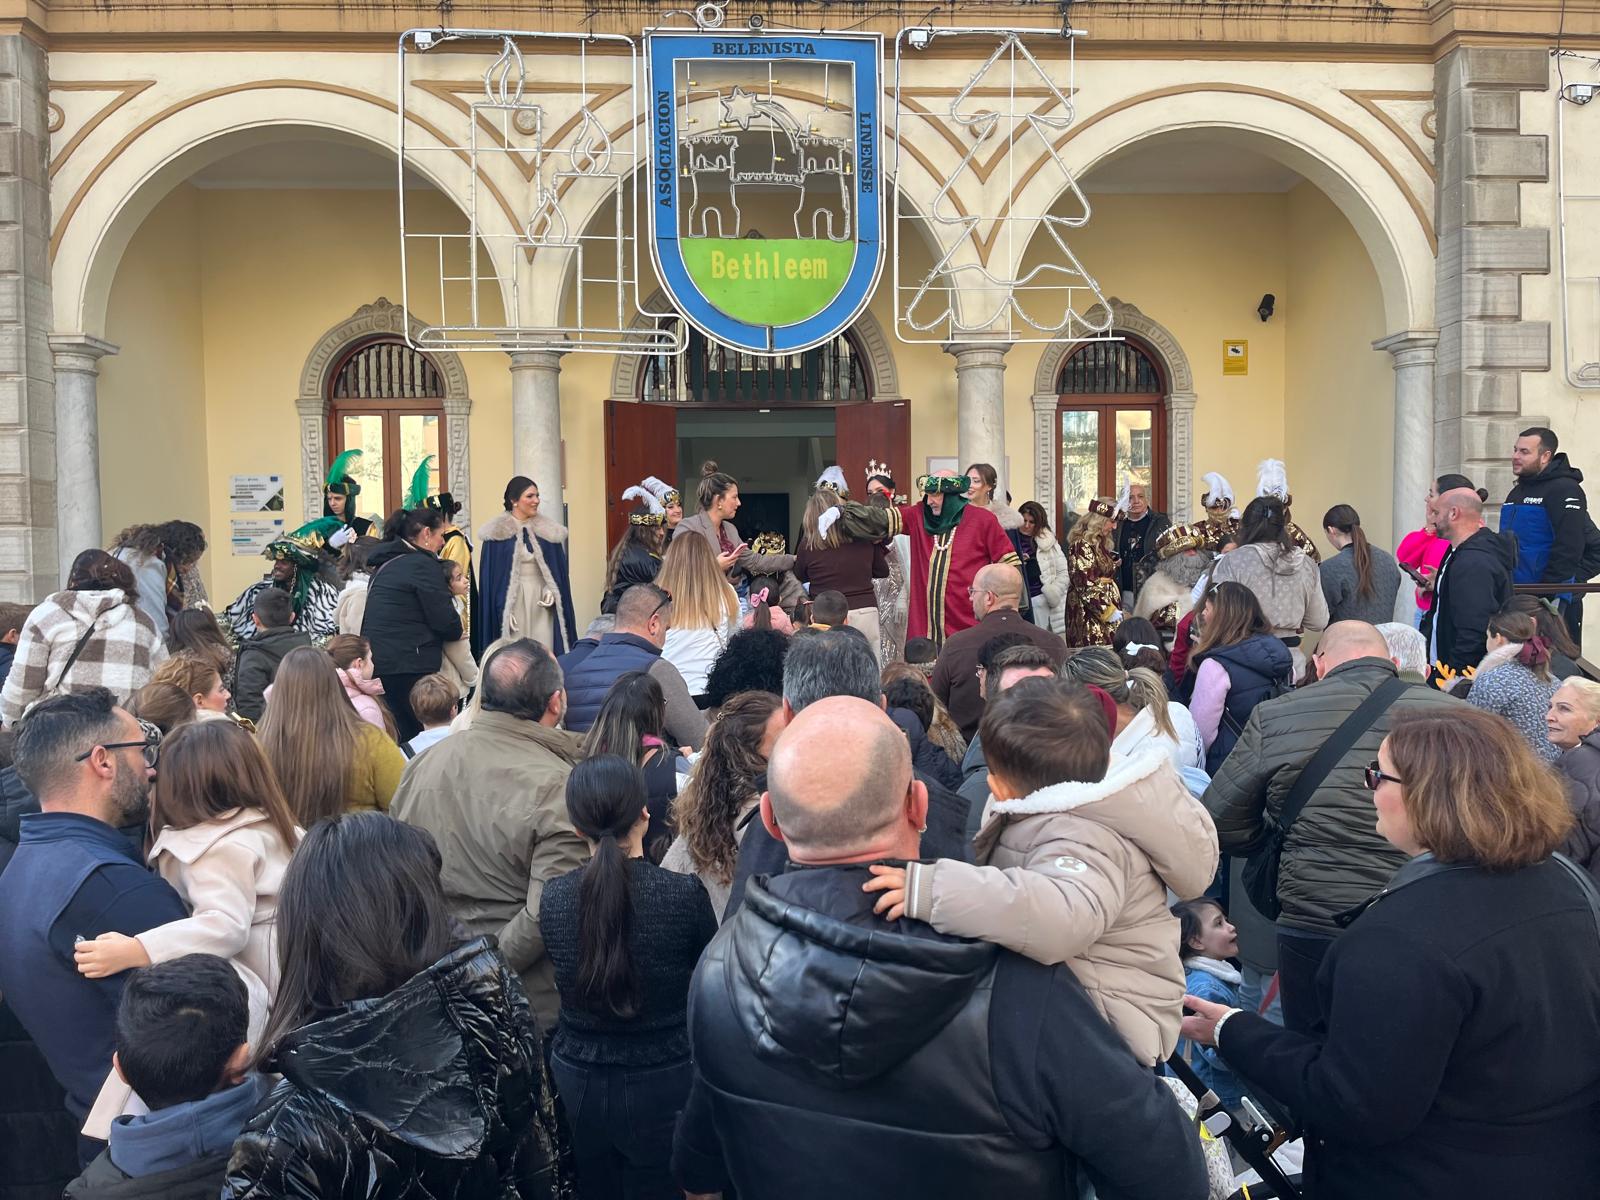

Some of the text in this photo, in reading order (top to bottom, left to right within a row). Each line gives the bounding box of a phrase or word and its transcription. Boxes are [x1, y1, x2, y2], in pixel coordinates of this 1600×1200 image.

[712, 42, 816, 55] BELENISTA
[658, 90, 672, 208] ASOCIACION
[860, 112, 873, 193] LINENSE
[711, 250, 828, 280] Bethleem
